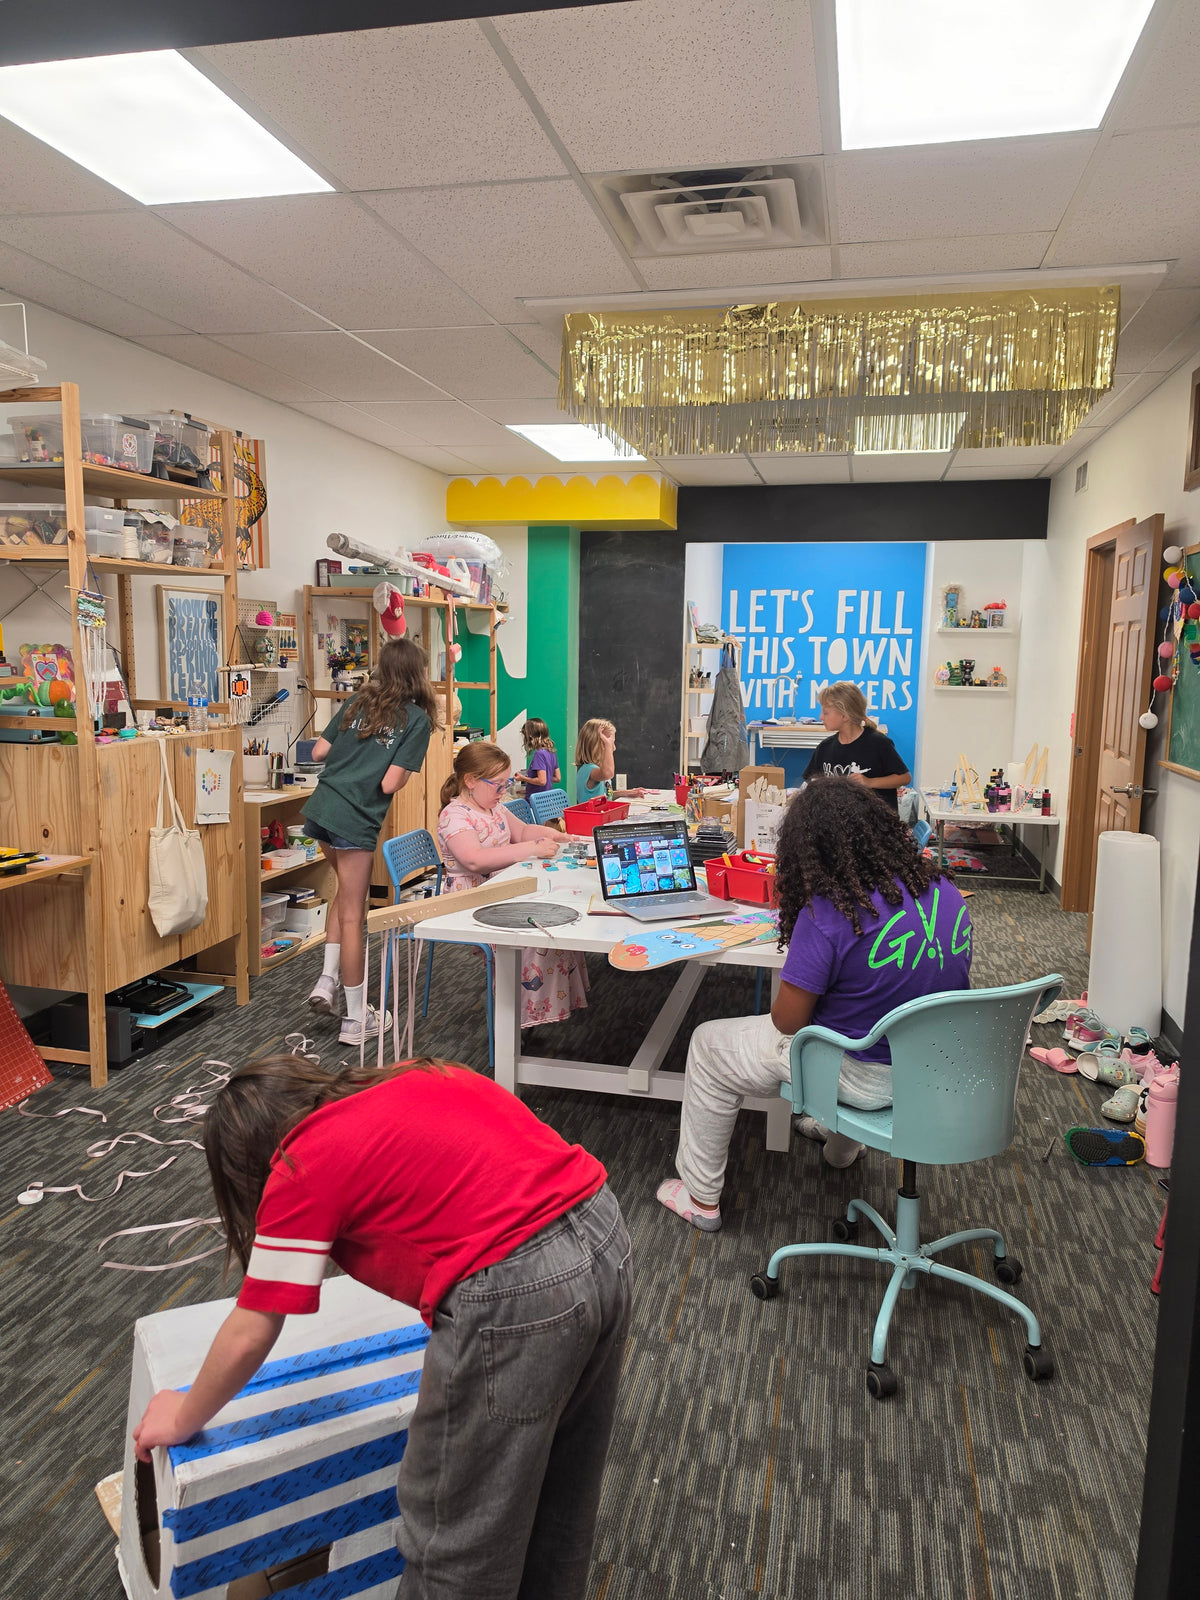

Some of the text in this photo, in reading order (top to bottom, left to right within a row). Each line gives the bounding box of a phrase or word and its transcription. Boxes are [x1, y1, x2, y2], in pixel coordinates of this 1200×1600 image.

[168, 597, 218, 619] SHOW UP
[729, 589, 913, 635] LET'S FILL
[168, 615, 218, 641] BREATHE
[169, 649, 219, 674] BE KIND
[808, 636, 913, 676] TOWN
